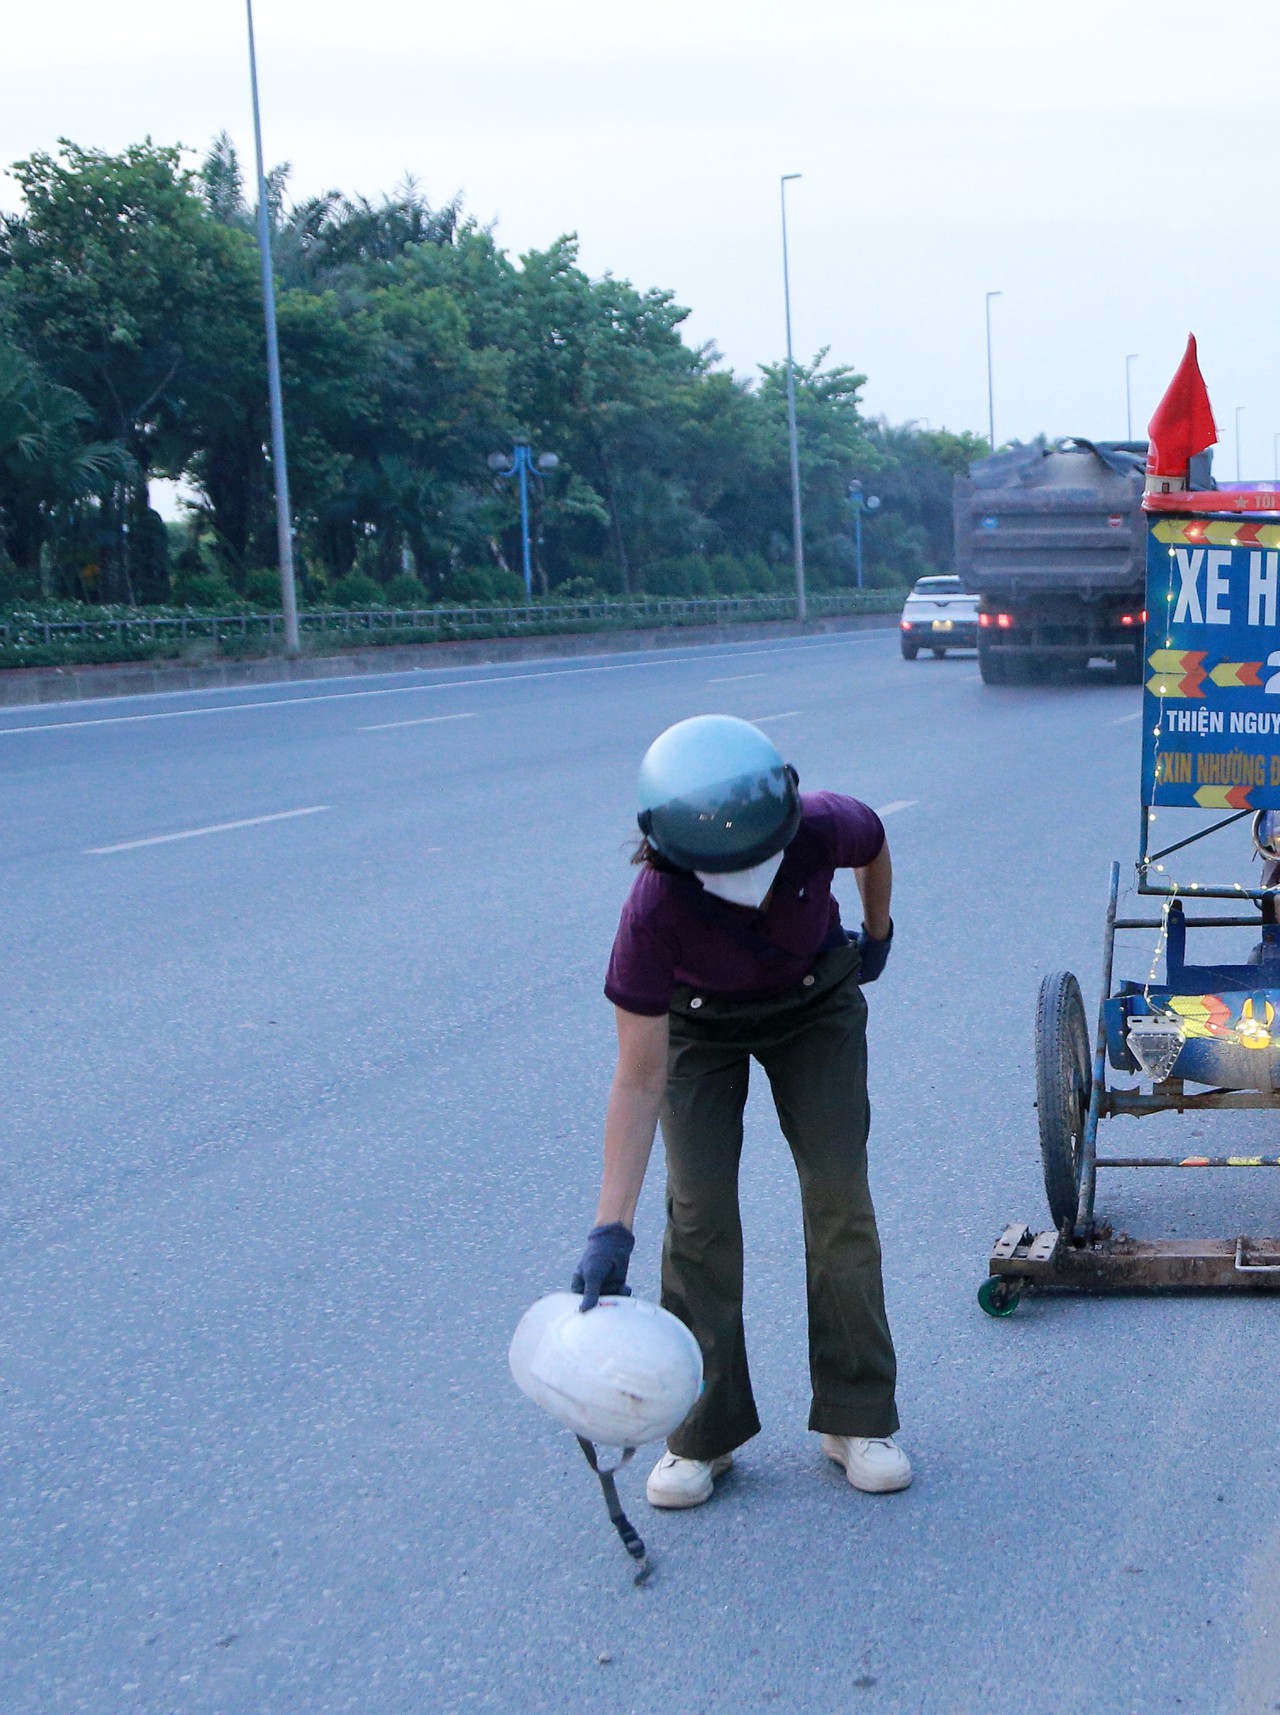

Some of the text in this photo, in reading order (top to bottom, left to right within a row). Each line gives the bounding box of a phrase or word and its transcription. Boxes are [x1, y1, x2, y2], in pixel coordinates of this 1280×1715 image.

[1254, 492, 1275, 508] TÔI
[1172, 549, 1232, 625] XE
[1166, 706, 1223, 737] THIỆN
